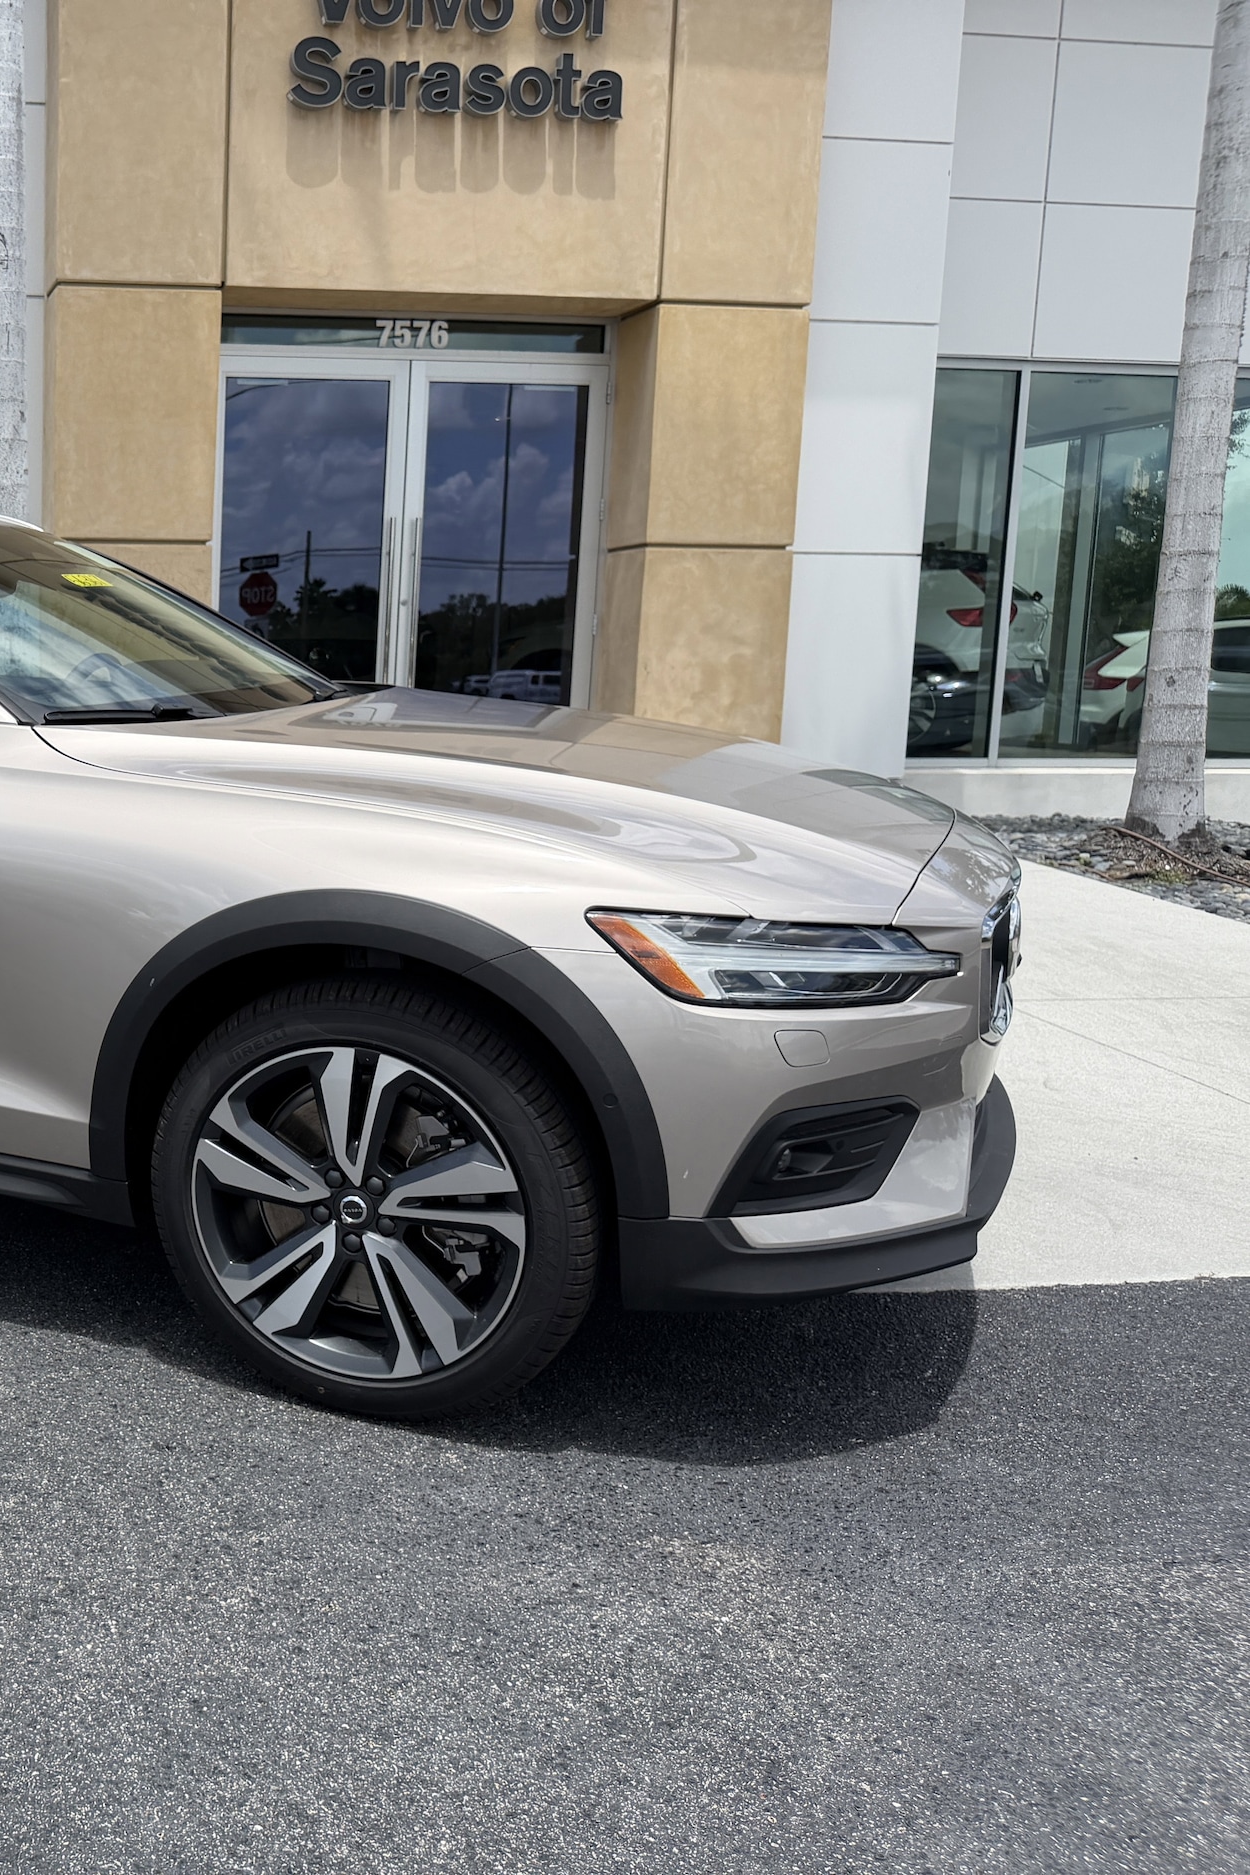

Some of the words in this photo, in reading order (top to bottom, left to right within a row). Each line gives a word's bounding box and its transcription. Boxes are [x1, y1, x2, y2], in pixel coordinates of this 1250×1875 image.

[287, 36, 623, 120] Sarasota
[375, 319, 449, 349] 7576
[227, 1025, 288, 1066] PIRELLI
